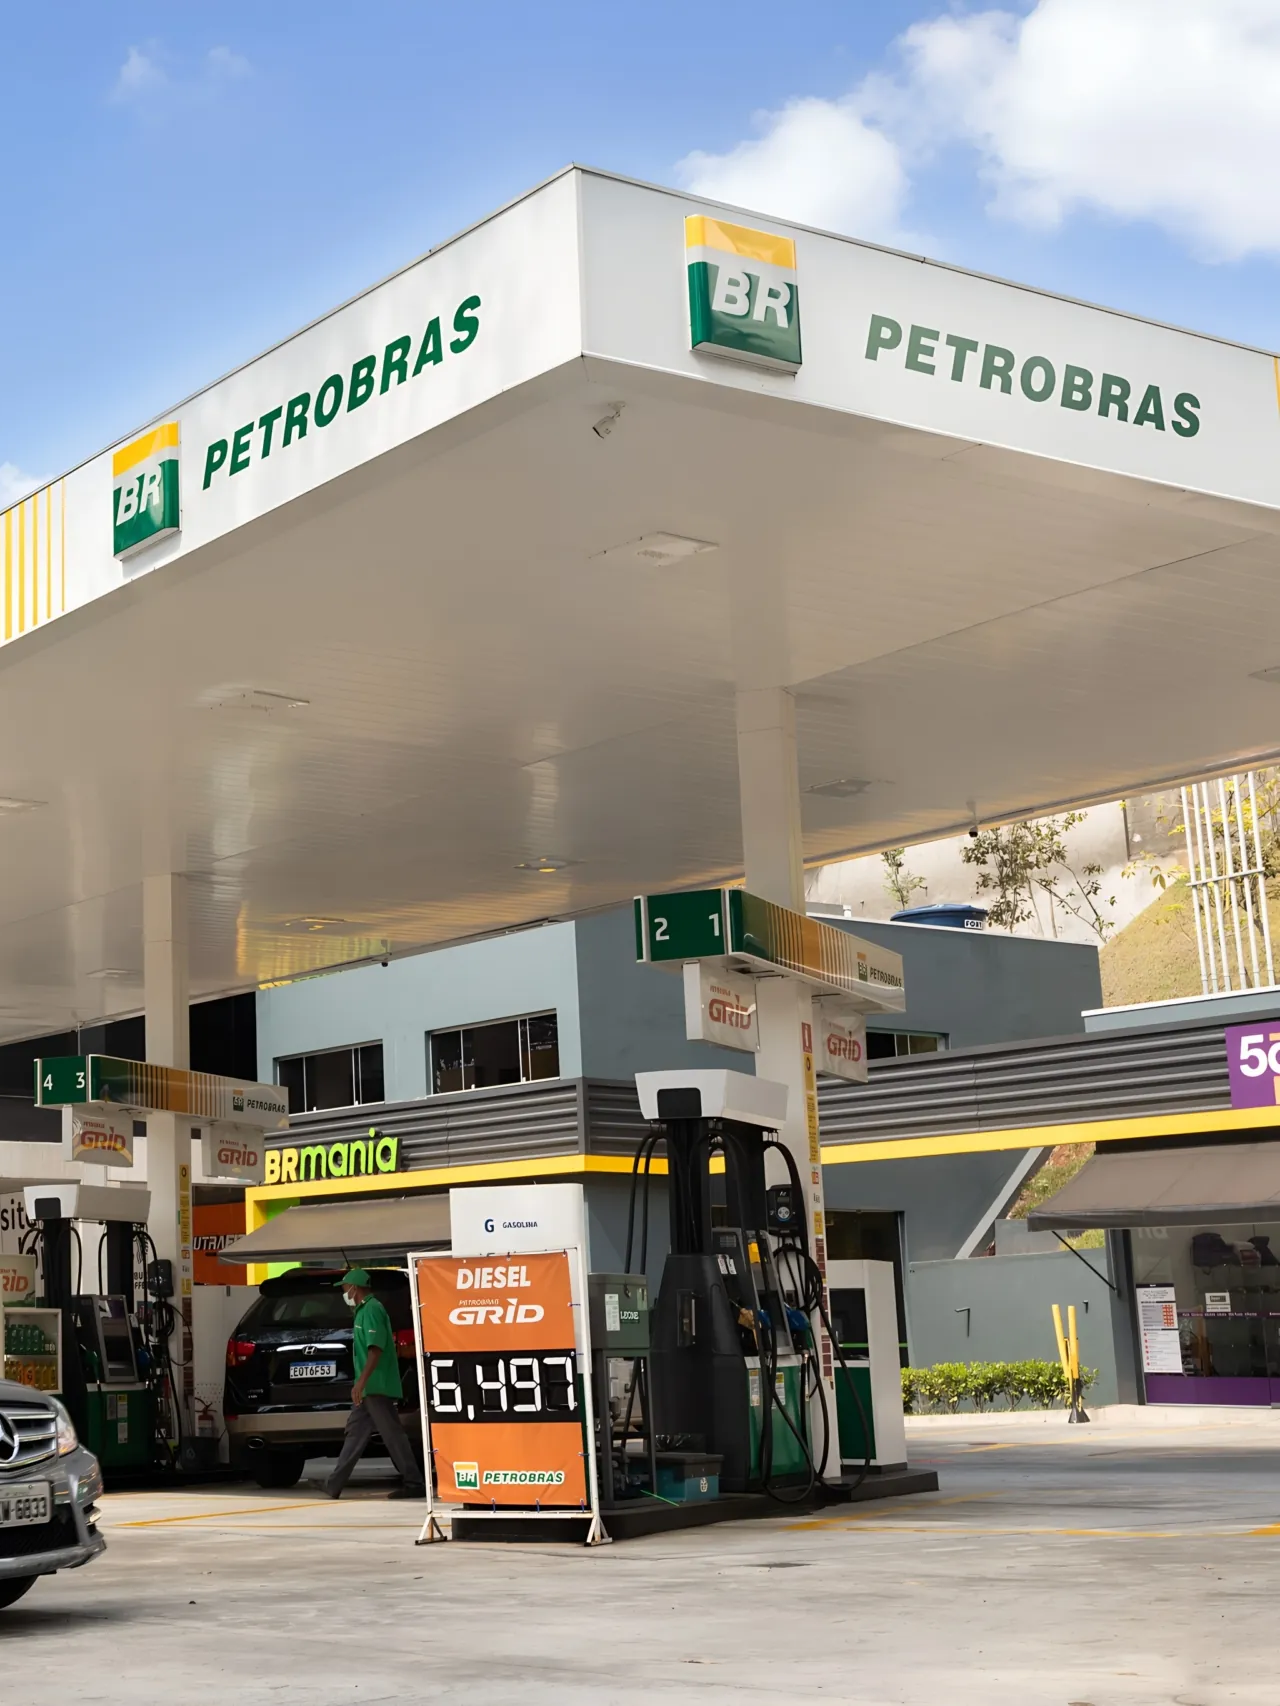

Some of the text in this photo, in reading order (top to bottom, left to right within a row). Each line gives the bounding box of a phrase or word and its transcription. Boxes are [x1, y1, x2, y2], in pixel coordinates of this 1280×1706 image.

[711, 264, 792, 328] BR
[864, 313, 1201, 438] PETROBRAS
[203, 294, 481, 491] PETROBRAS
[116, 461, 163, 526] BR
[653, 912, 720, 941] 2 1
[708, 994, 752, 1030] GRID
[827, 1030, 862, 1062] GRID
[43, 1071, 85, 1091] 4 3
[246, 1098, 286, 1114] PETROBRAS
[81, 1126, 126, 1152] GRID
[217, 1143, 258, 1167] GRID
[264, 1127, 401, 1184] BRmania
[484, 1218, 538, 1233] G GASOLINA
[456, 1265, 531, 1290] DIESEL
[448, 1298, 545, 1326] GRID
[430, 1356, 575, 1421] 6,497
[484, 1472, 563, 1483] PETROBRAS
